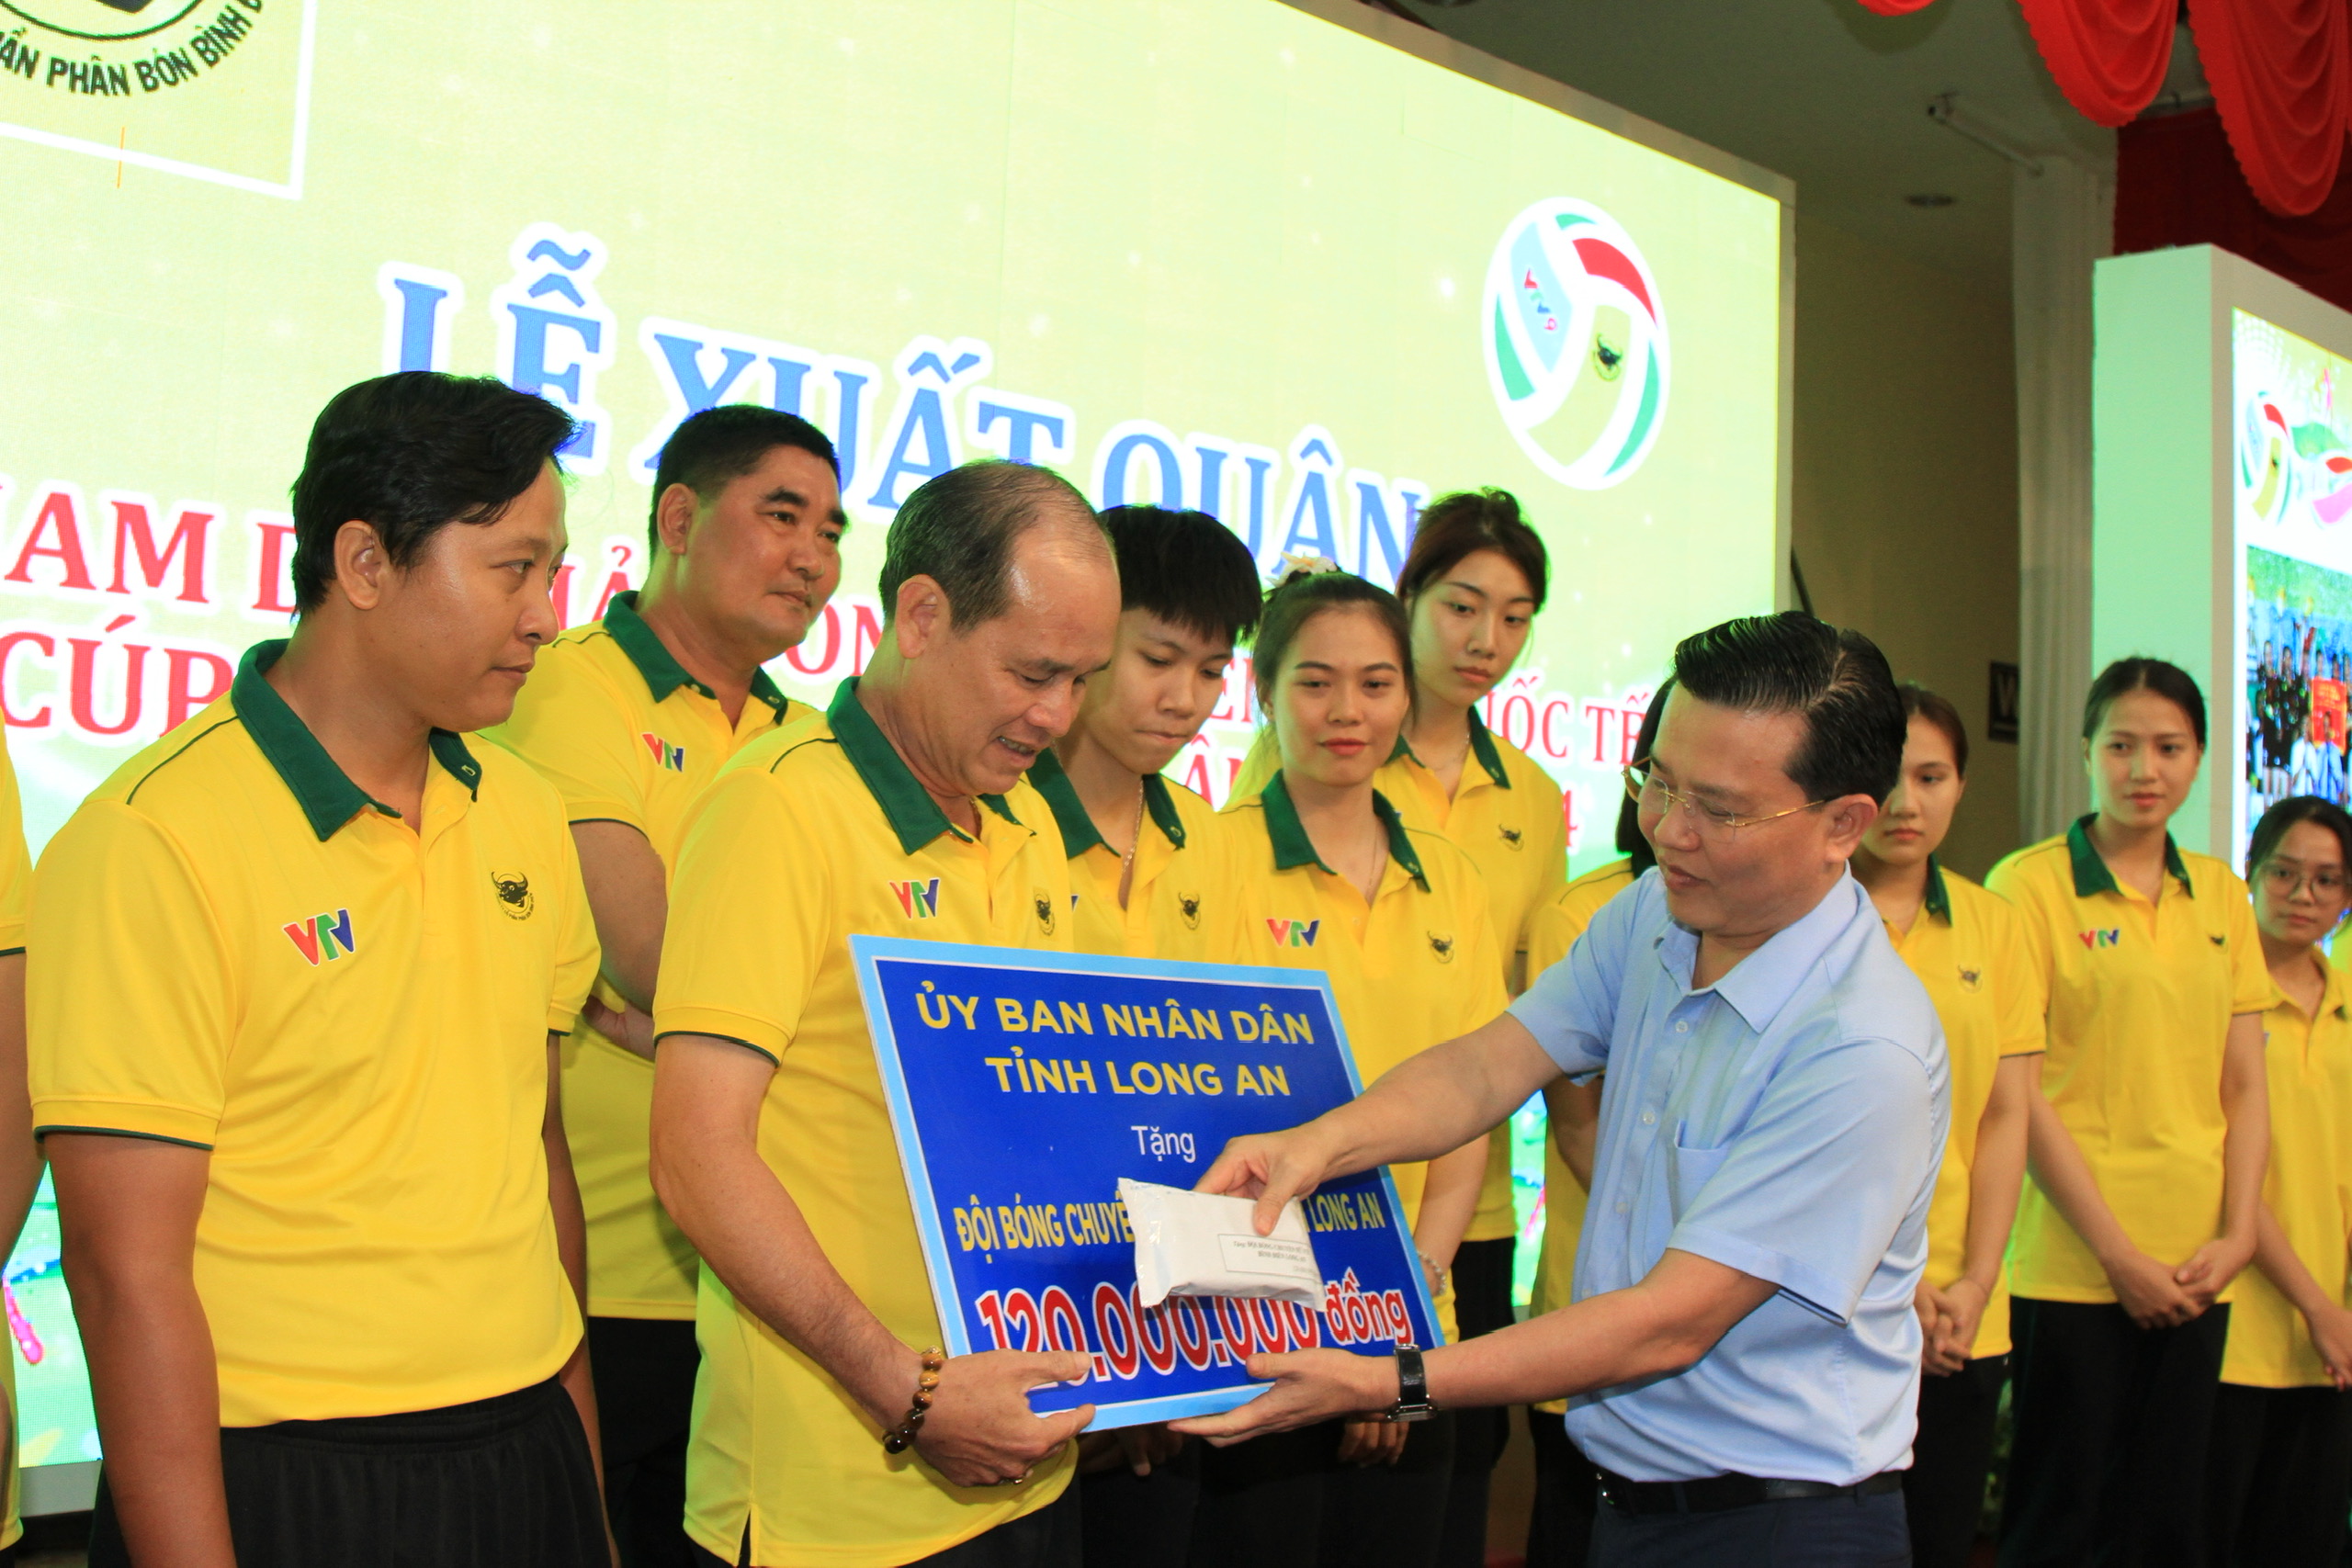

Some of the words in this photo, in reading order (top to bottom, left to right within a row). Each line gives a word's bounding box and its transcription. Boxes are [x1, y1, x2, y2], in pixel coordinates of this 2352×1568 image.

[46, 54, 130, 96] PHÂN
[133, 47, 198, 93] BÓN
[3, 491, 215, 604] AM
[0, 614, 233, 739] CÚP
[916, 980, 979, 1030] ỦY
[995, 998, 1094, 1035] BAN
[1102, 998, 1225, 1041] NHÂN
[1231, 1003, 1315, 1044] DÂN
[985, 1045, 1098, 1094] TỈNH
[1106, 1061, 1224, 1096] LONG
[1236, 1065, 1291, 1097] AN
[1131, 1125, 1196, 1163] Tặng
[954, 1194, 1001, 1264] ĐỘI
[998, 1192, 1065, 1249] BÓNG
[1306, 1193, 1358, 1232] LONG
[1357, 1192, 1386, 1229] AN
[1324, 1267, 1415, 1345] đồng
